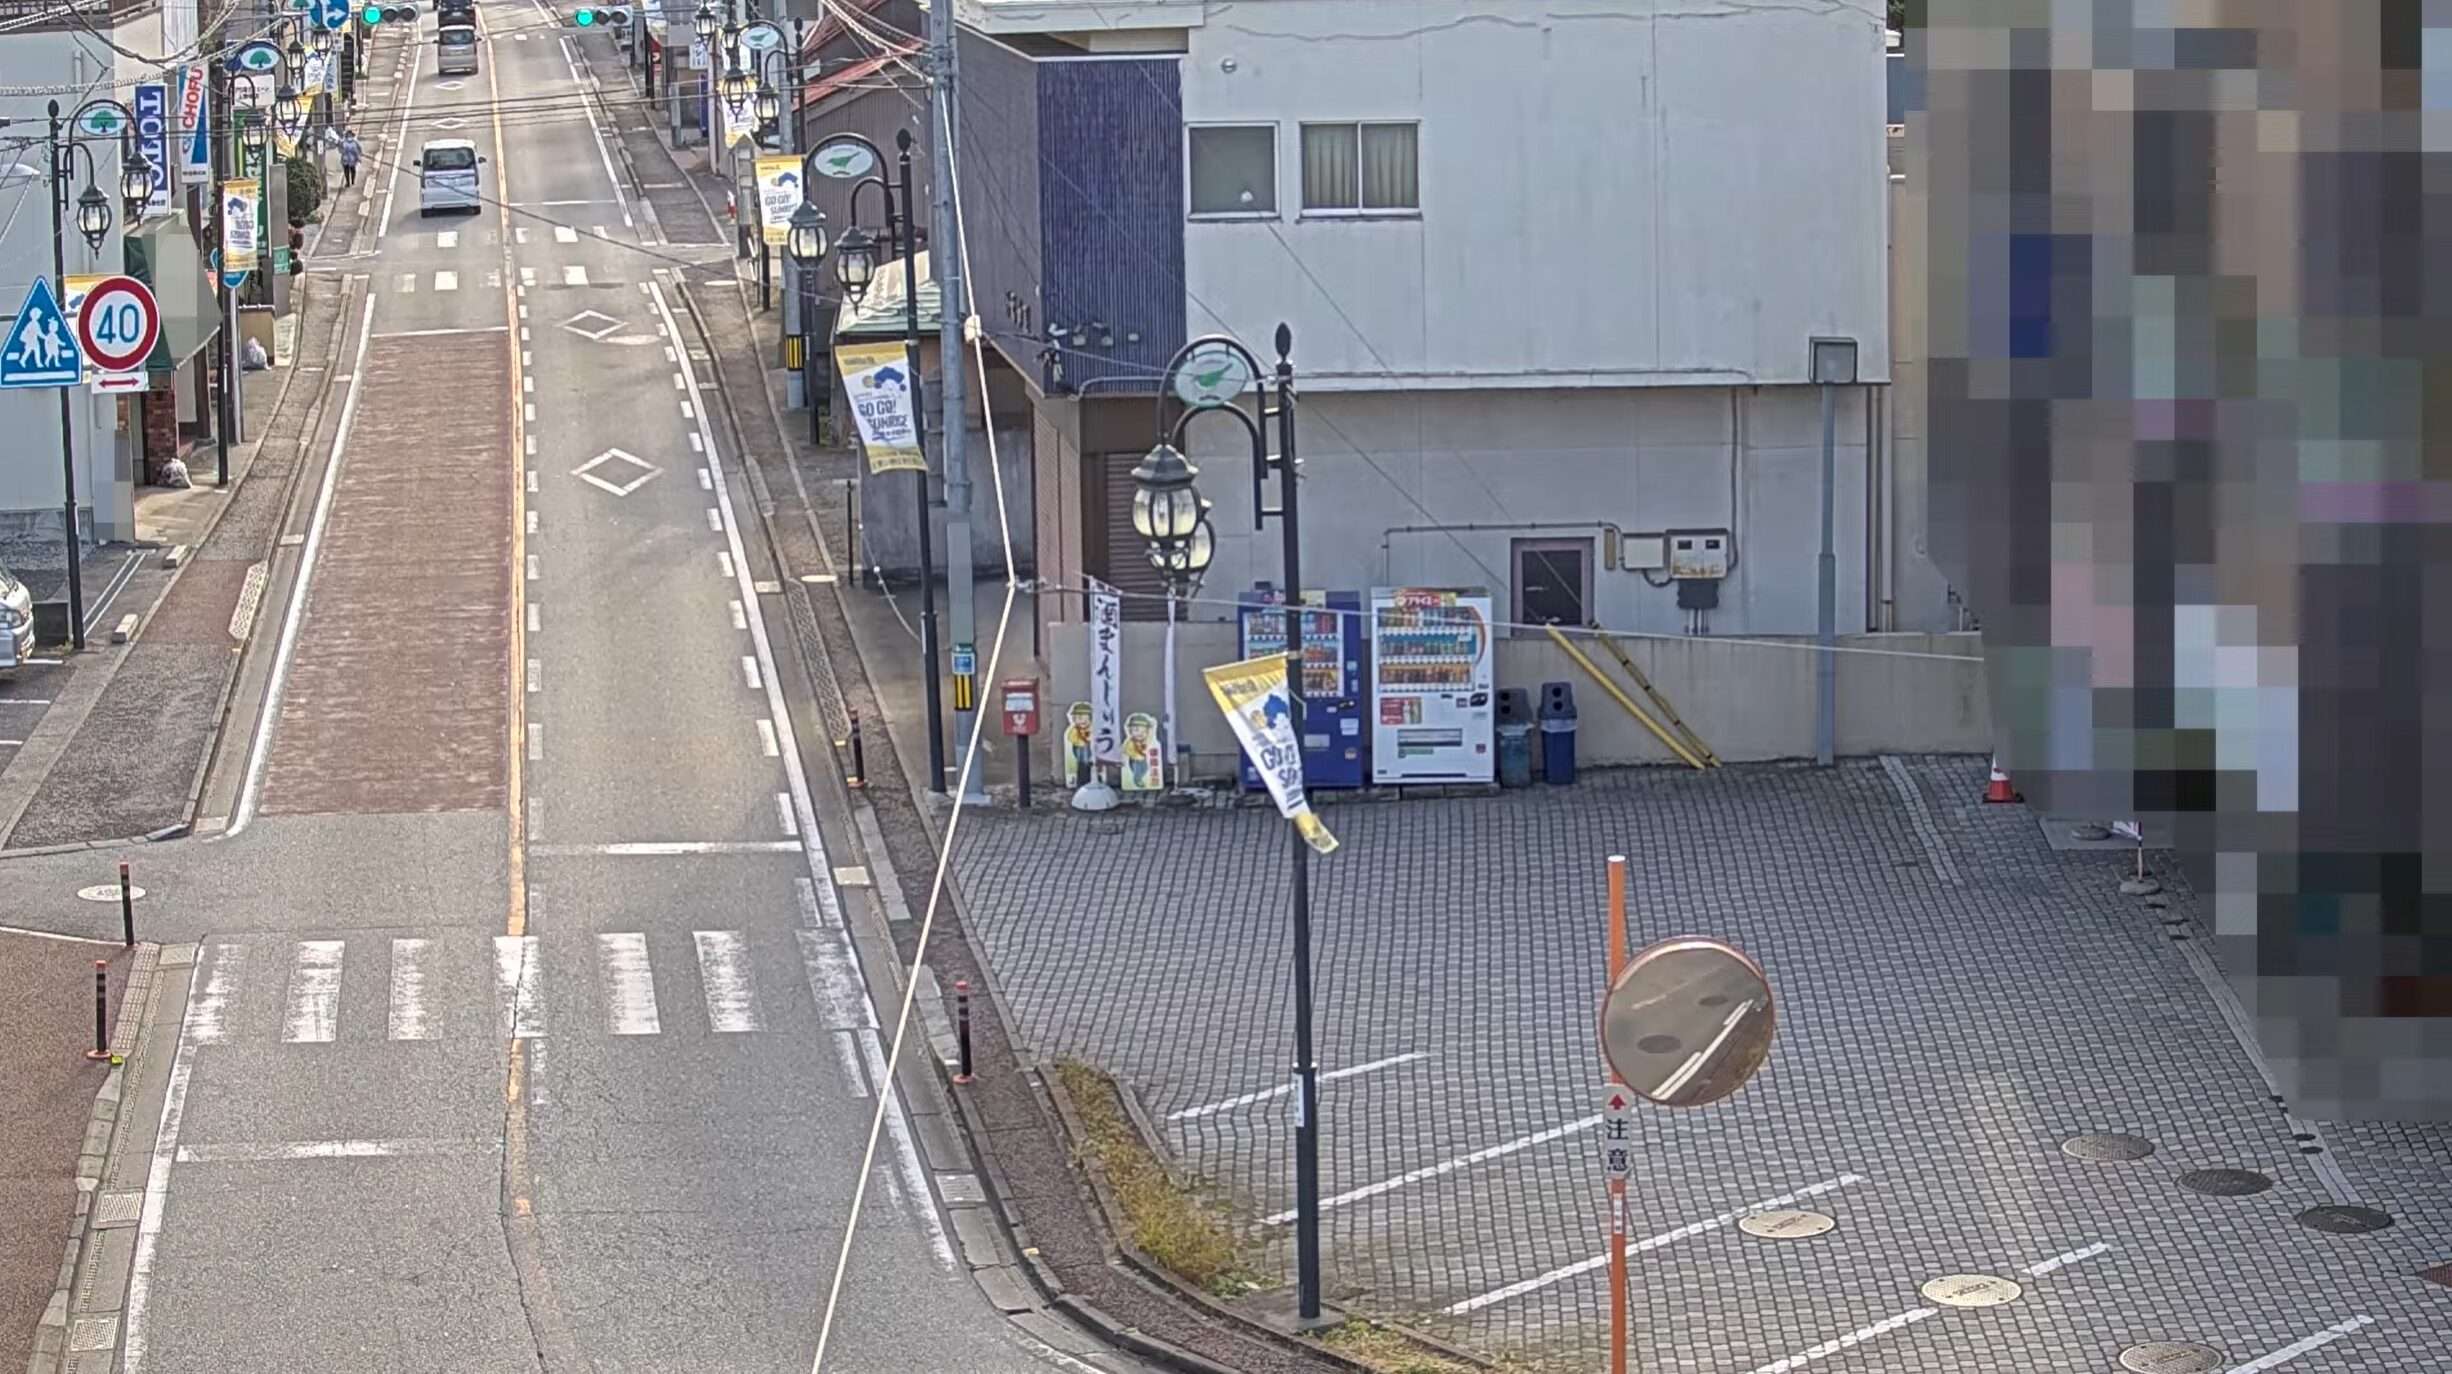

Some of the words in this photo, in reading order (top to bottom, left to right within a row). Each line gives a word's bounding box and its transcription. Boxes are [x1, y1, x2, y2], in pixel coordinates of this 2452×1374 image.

[183, 66, 203, 129] CHOFU
[96, 304, 139, 344] 40
[1606, 1118, 1629, 1172] 注意
